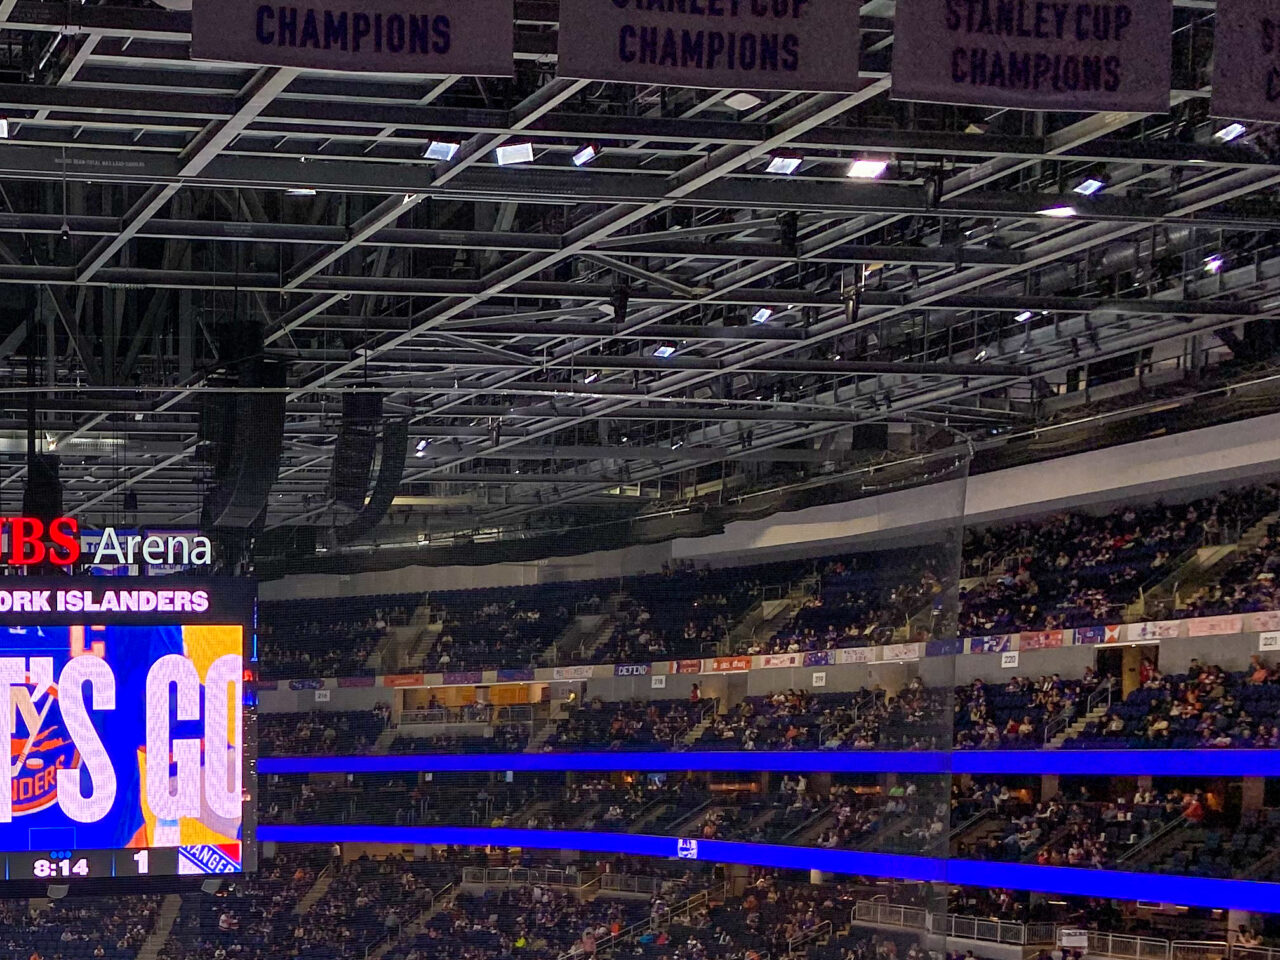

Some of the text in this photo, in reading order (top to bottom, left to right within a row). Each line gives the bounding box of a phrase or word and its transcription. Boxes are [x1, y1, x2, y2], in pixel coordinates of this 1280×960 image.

[256, 5, 451, 55] CHAMPIONS
[620, 24, 799, 72] CHAMPIONS
[951, 47, 1120, 92] CHAMPIONS
[94, 527, 212, 565] Arena
[57, 590, 209, 612] ISLANDERS
[618, 666, 647, 676] DEFEND
[146, 654, 243, 821] GO
[33, 858, 89, 877] 8:14
[133, 850, 149, 873] 1
